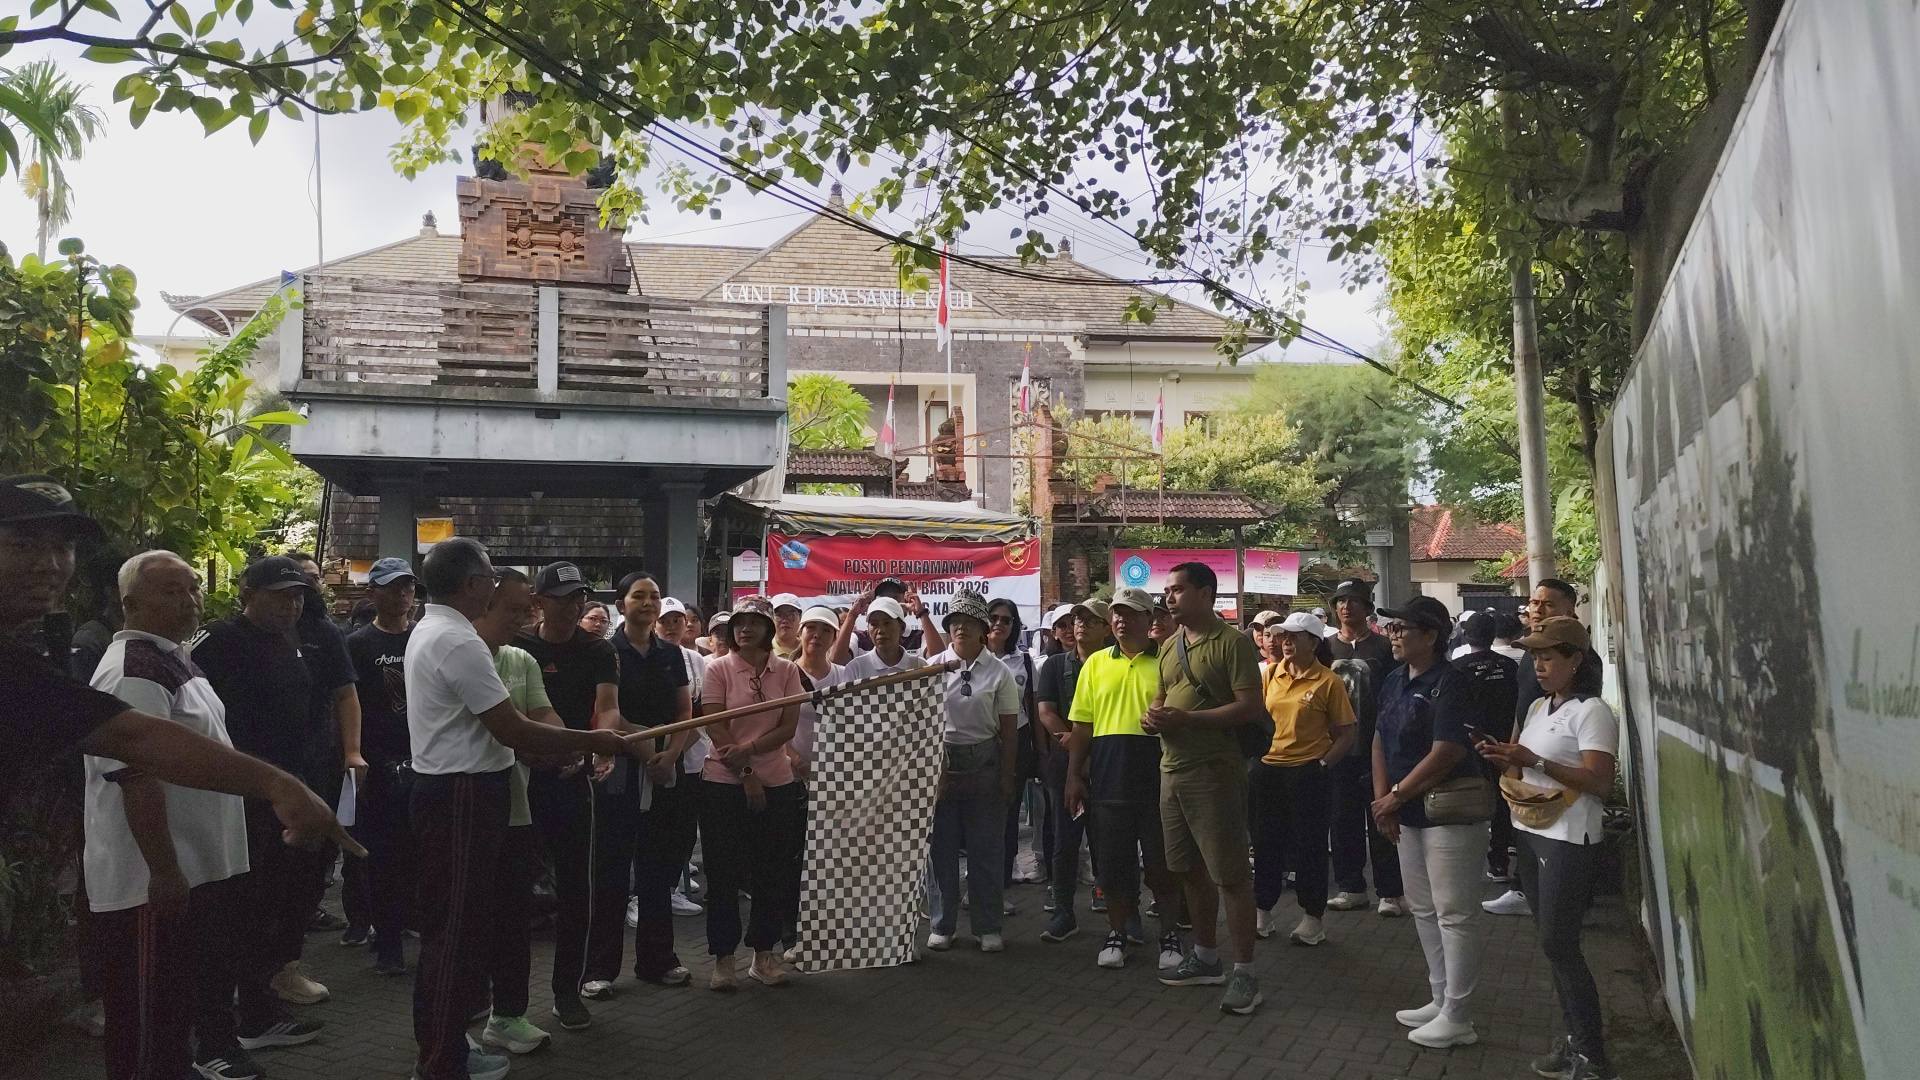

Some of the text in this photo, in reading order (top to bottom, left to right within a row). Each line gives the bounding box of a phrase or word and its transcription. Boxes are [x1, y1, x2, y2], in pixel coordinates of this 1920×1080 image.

[722, 282, 801, 305] KANTR
[807, 286, 850, 306] DESA
[925, 290, 973, 310] KUH
[844, 559, 974, 575] POSKO PENGAMANAN
[921, 581, 955, 596] BARU
